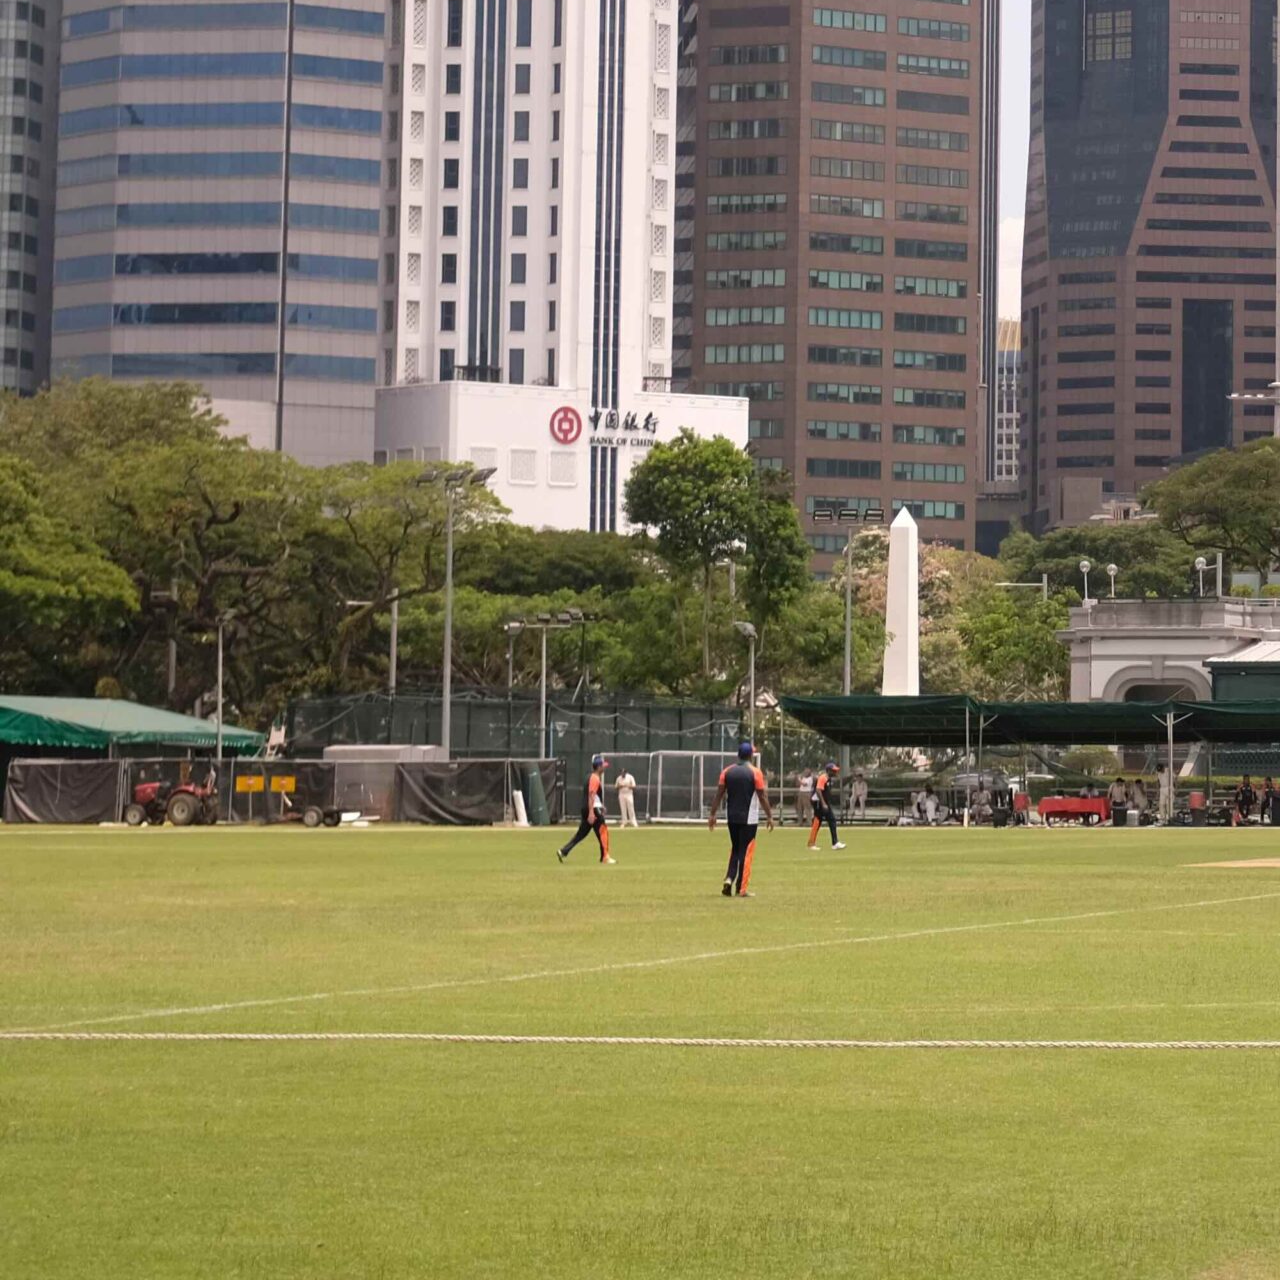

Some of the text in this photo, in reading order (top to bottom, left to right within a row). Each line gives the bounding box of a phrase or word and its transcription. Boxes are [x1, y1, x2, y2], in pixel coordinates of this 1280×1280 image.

[589, 436, 654, 447] BANK OF CHIN
